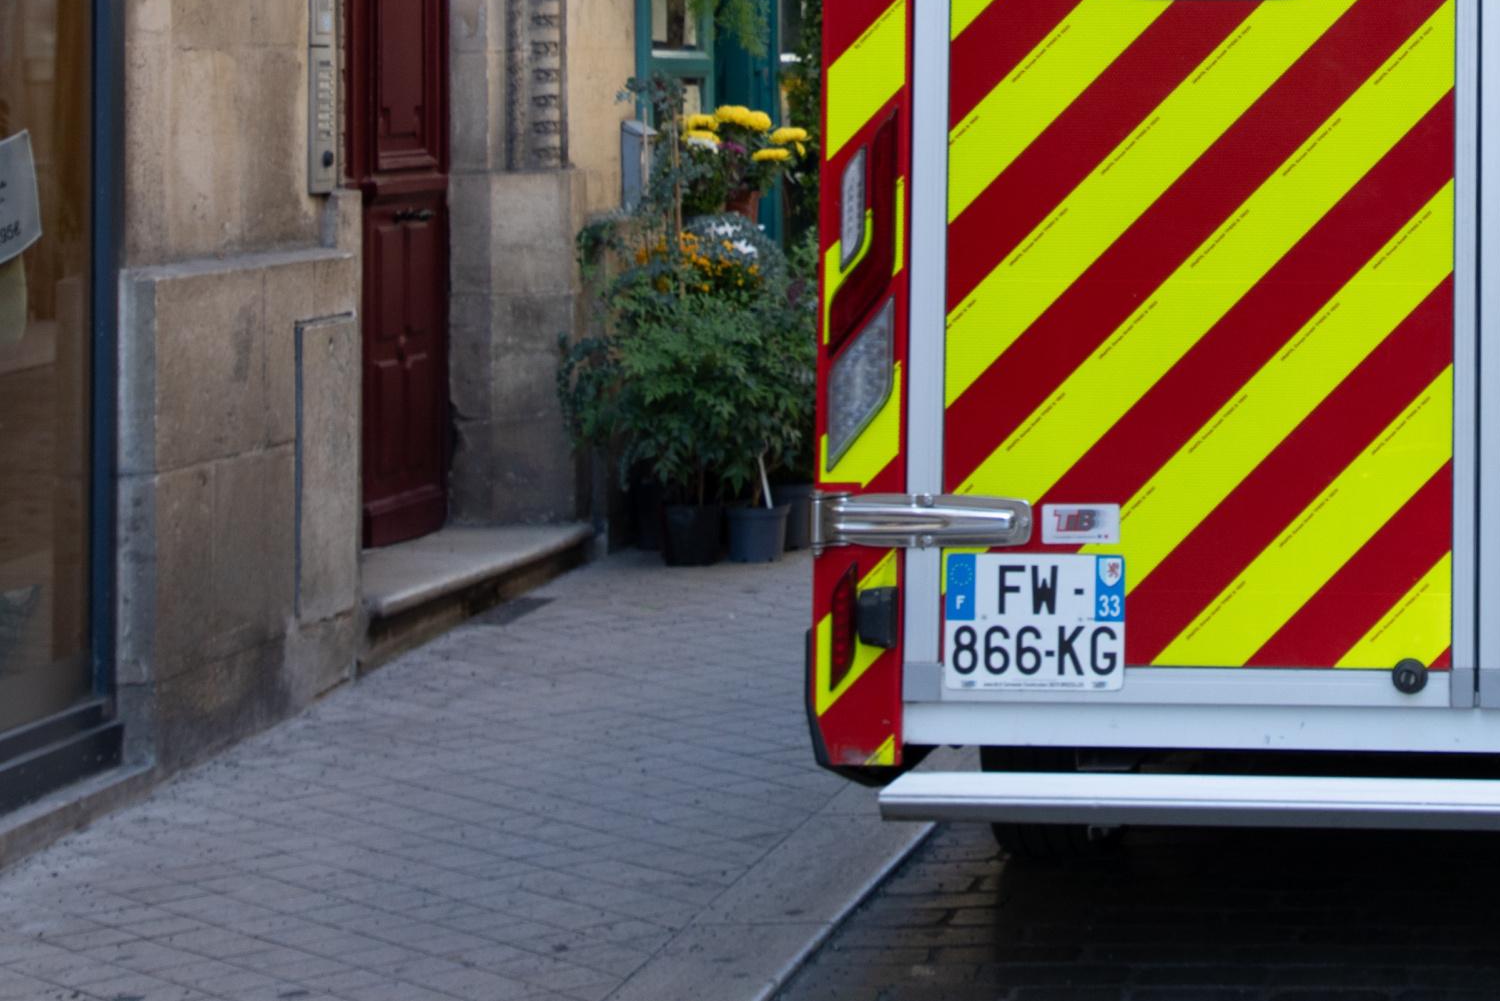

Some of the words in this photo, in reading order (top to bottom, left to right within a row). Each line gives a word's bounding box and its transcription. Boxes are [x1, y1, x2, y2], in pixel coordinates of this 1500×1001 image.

[956, 595, 966, 610] F
[1099, 594, 1121, 617] 33
[952, 625, 1118, 677] 866-KG
